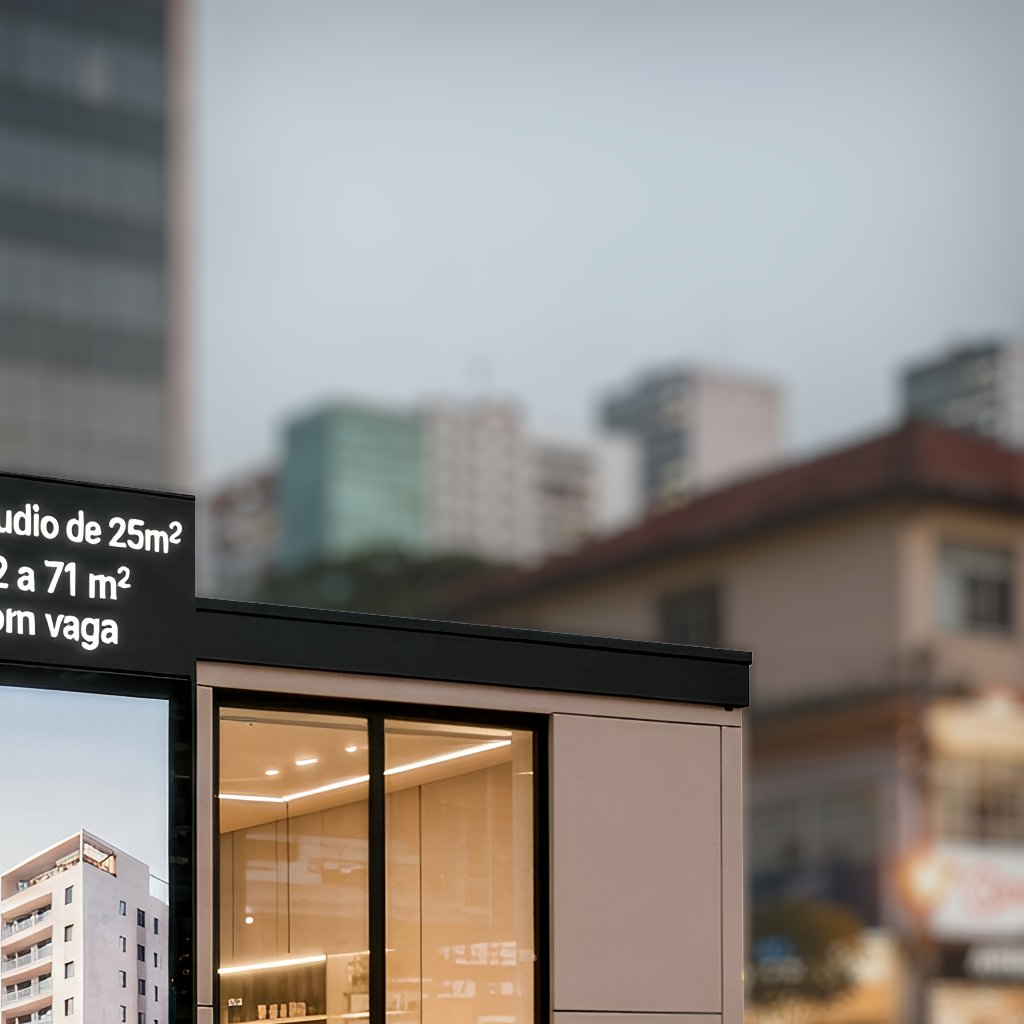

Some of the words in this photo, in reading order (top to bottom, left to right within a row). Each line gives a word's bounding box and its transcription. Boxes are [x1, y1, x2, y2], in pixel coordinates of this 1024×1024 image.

[65, 509, 102, 545] de
[108, 516, 183, 554] 25m²
[16, 566, 36, 593] a
[43, 559, 77, 597] 71
[88, 565, 132, 601] m²
[44, 613, 119, 651] vaga
